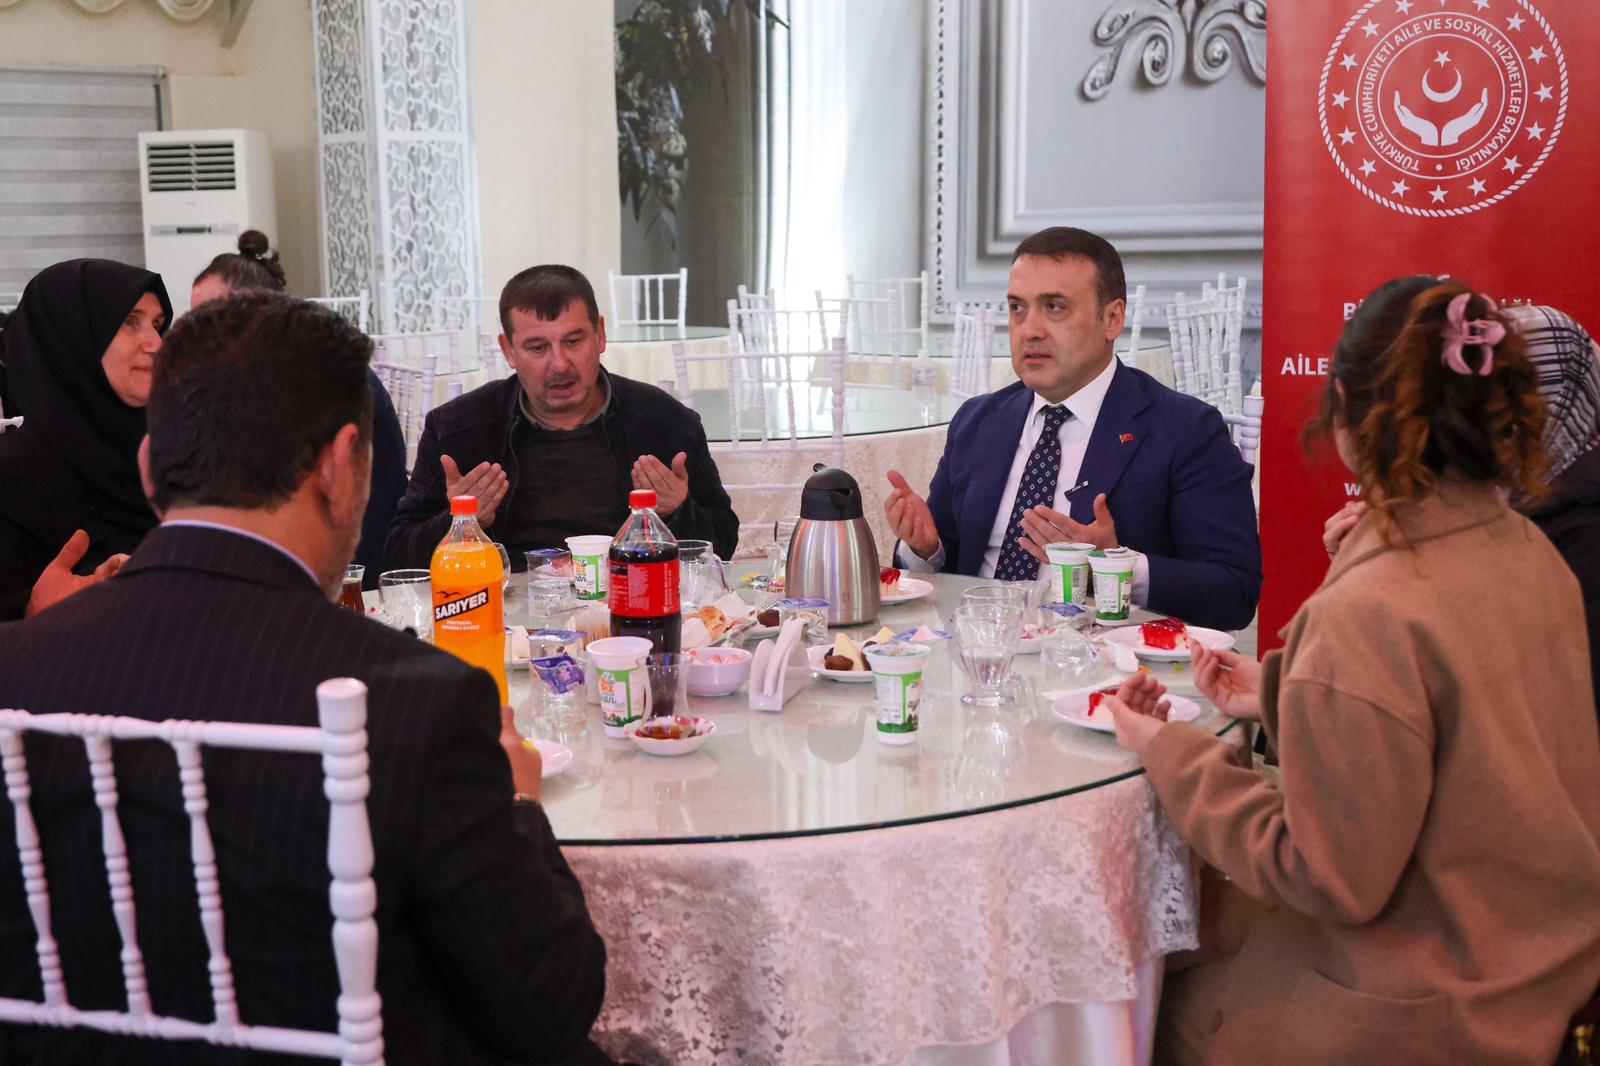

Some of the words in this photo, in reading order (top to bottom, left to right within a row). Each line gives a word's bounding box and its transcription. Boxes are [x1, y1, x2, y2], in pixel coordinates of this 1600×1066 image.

[1394, 23, 1423, 47] AİLE
[1423, 18, 1442, 32] VE
[1444, 18, 1494, 45] SOSYAL
[1362, 40, 1395, 132] CUMHURİYETİ
[1492, 39, 1522, 114] HİZMETLER
[1372, 131, 1420, 171] TÜRKİYE
[1455, 115, 1517, 172] BAKANLIĞI
[1280, 353, 1329, 376] AİLE
[435, 591, 487, 620] SARIYER
